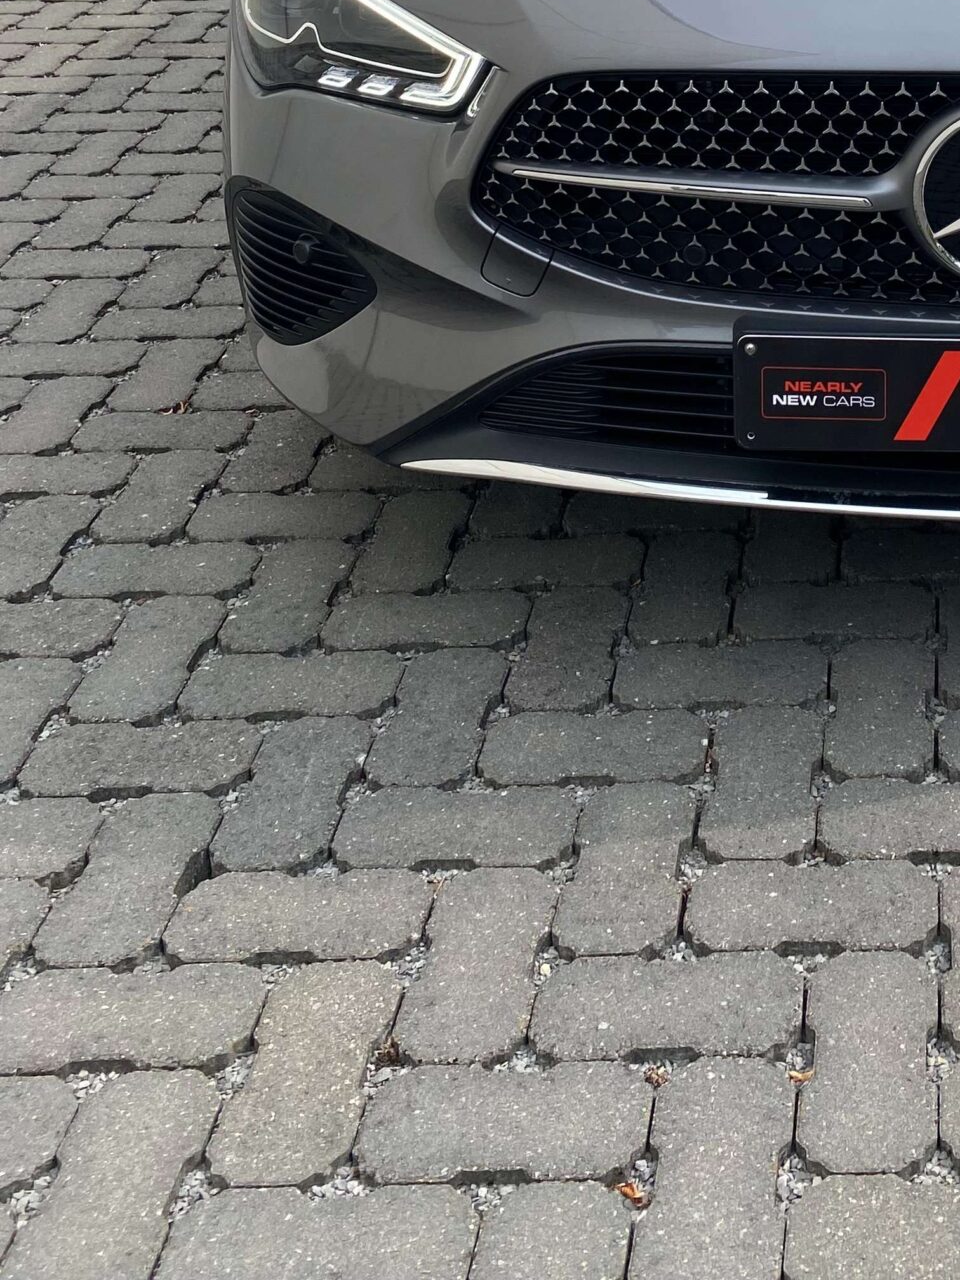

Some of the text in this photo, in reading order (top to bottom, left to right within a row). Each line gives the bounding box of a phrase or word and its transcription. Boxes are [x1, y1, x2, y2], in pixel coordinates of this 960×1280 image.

[784, 380, 863, 393] NEARLY
[772, 394, 875, 408] NEW CARS
